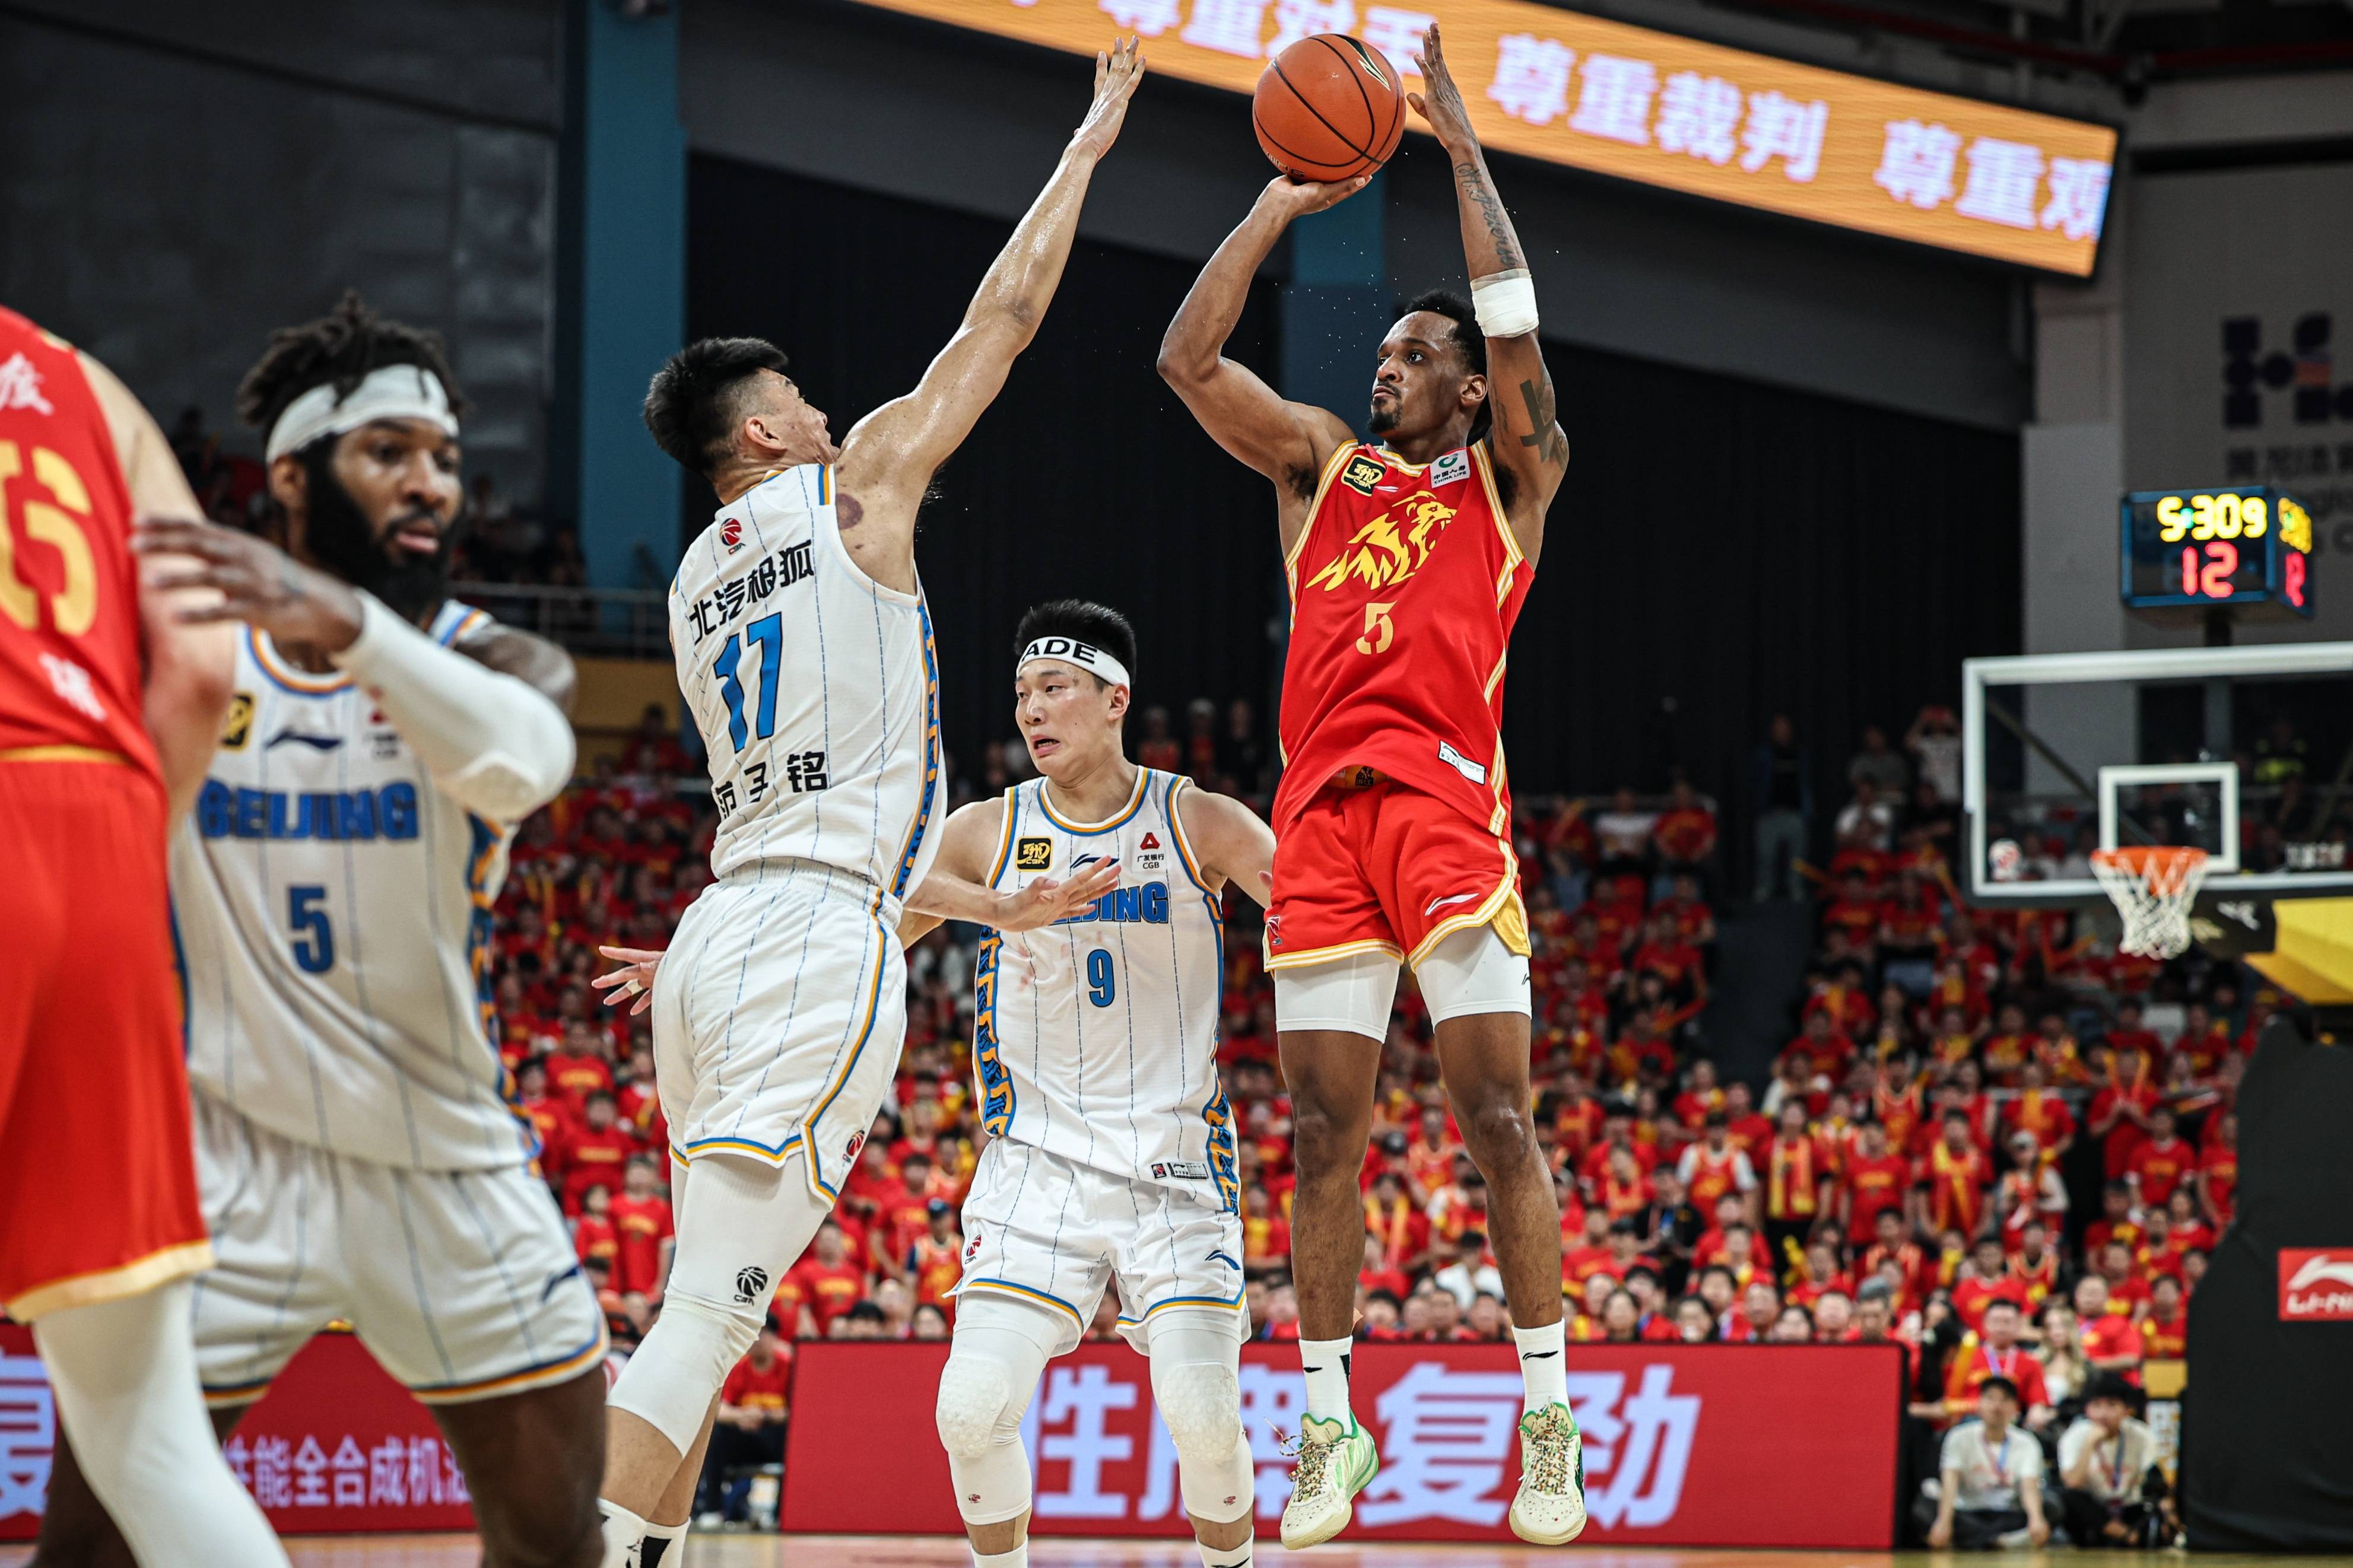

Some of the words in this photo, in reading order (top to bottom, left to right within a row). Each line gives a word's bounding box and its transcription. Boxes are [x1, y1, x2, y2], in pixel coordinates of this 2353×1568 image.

[1486, 33, 1829, 184] 尊重裁判
[1434, 465, 1466, 480] 中国人寿
[1434, 475, 1452, 485] CHINA
[689, 539, 815, 646] 北汽极狐
[2182, 541, 2238, 598] 12
[1355, 599, 1398, 655] 5
[713, 611, 783, 754] 17
[196, 777, 421, 841] BEIJING
[1137, 854, 1164, 862] 广发银行
[287, 885, 334, 974] 5
[1049, 881, 1169, 925] JING
[1087, 949, 1115, 1008] 9
